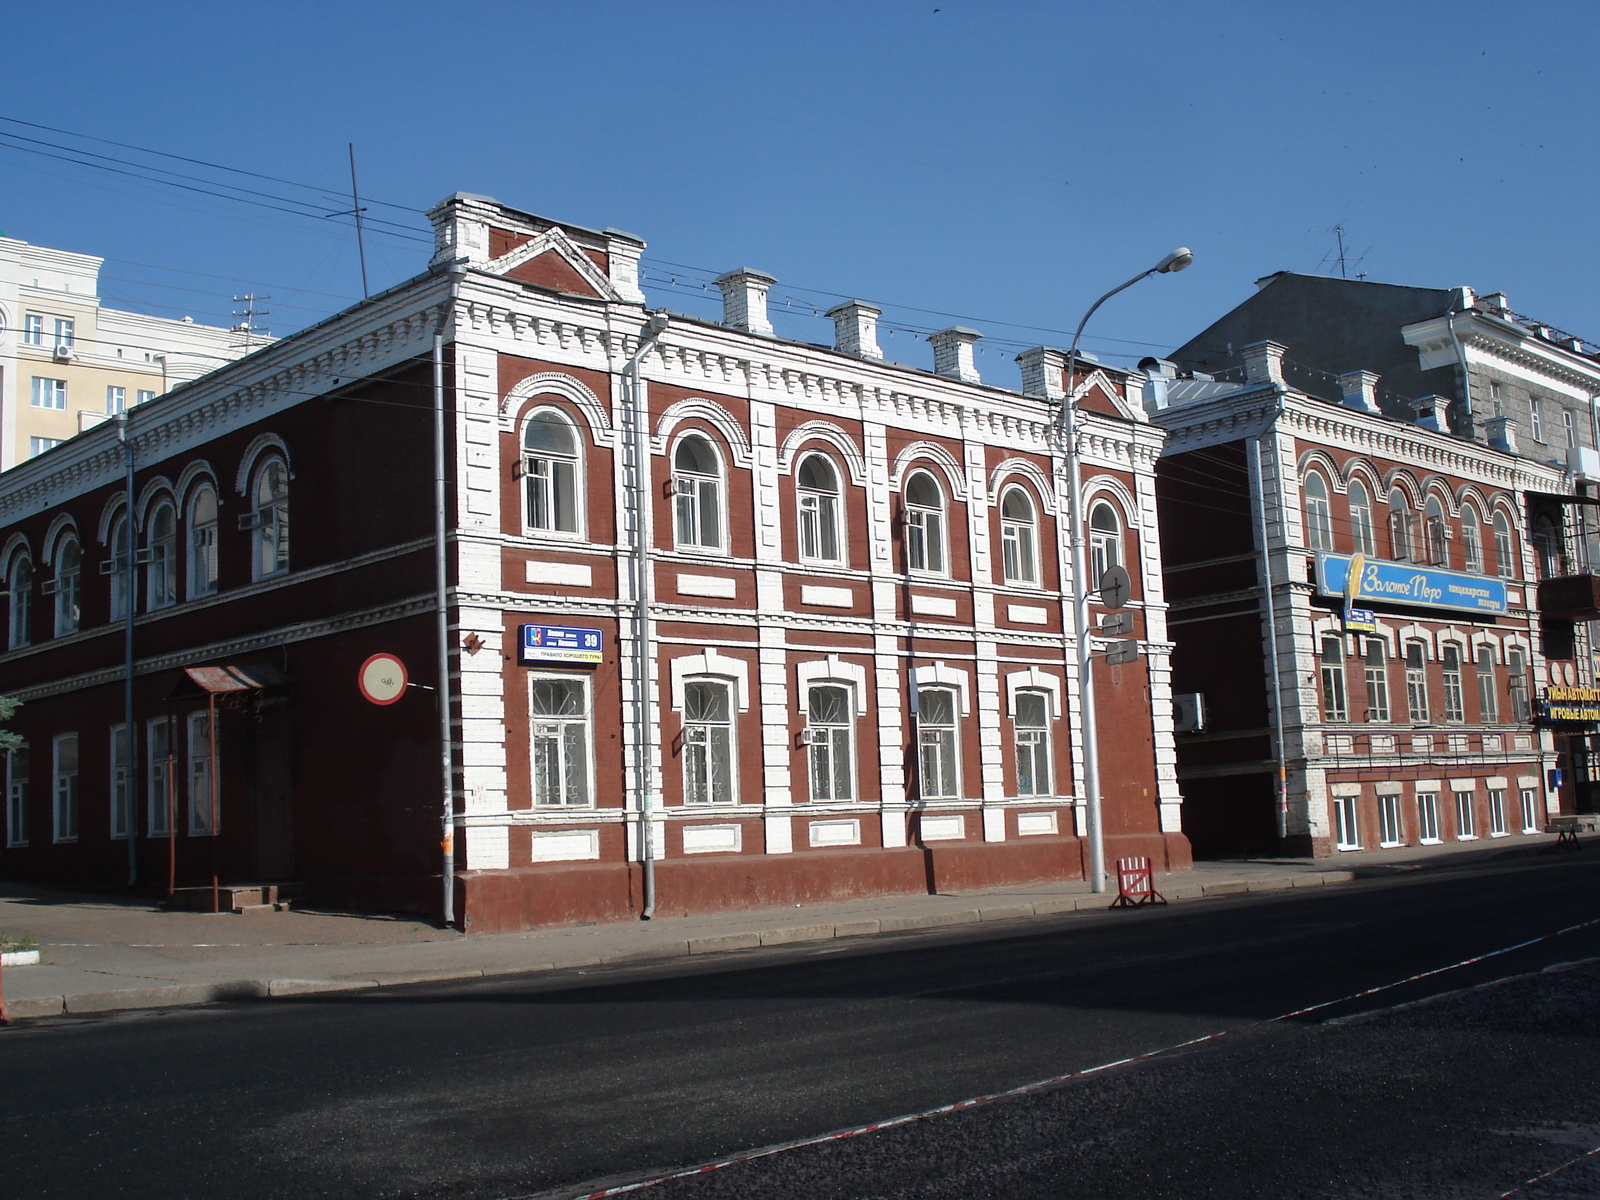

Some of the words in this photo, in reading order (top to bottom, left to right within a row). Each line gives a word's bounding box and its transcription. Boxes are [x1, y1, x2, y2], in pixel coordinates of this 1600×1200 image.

[1363, 565, 1410, 595] Золотое
[1409, 574, 1442, 602] Перо
[584, 634, 597, 647] 39
[1549, 706, 1580, 720] ИГРОВЫЕ
